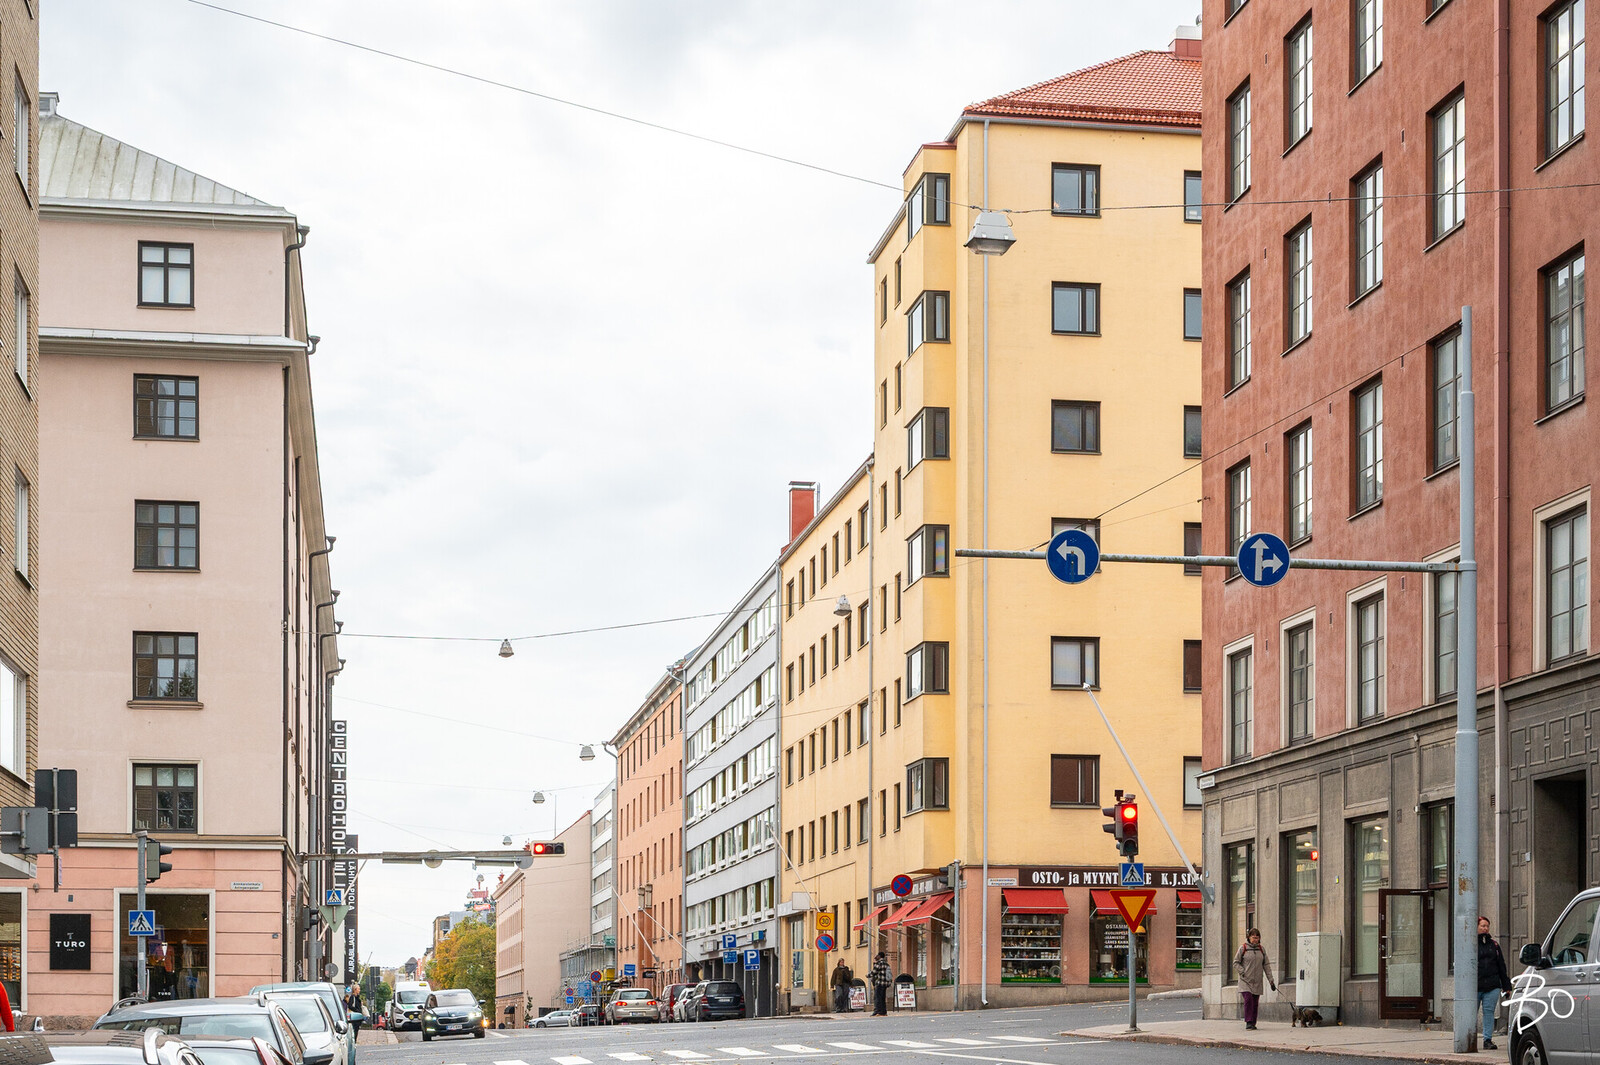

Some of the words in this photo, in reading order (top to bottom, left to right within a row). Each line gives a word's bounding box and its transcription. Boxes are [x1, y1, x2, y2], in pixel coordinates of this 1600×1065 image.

[1031, 871, 1065, 884] OSTO-
[1068, 871, 1080, 886] ja
[822, 917, 830, 925] 30
[55, 940, 86, 948] TURO
[725, 935, 735, 948] P
[747, 950, 757, 964] P
